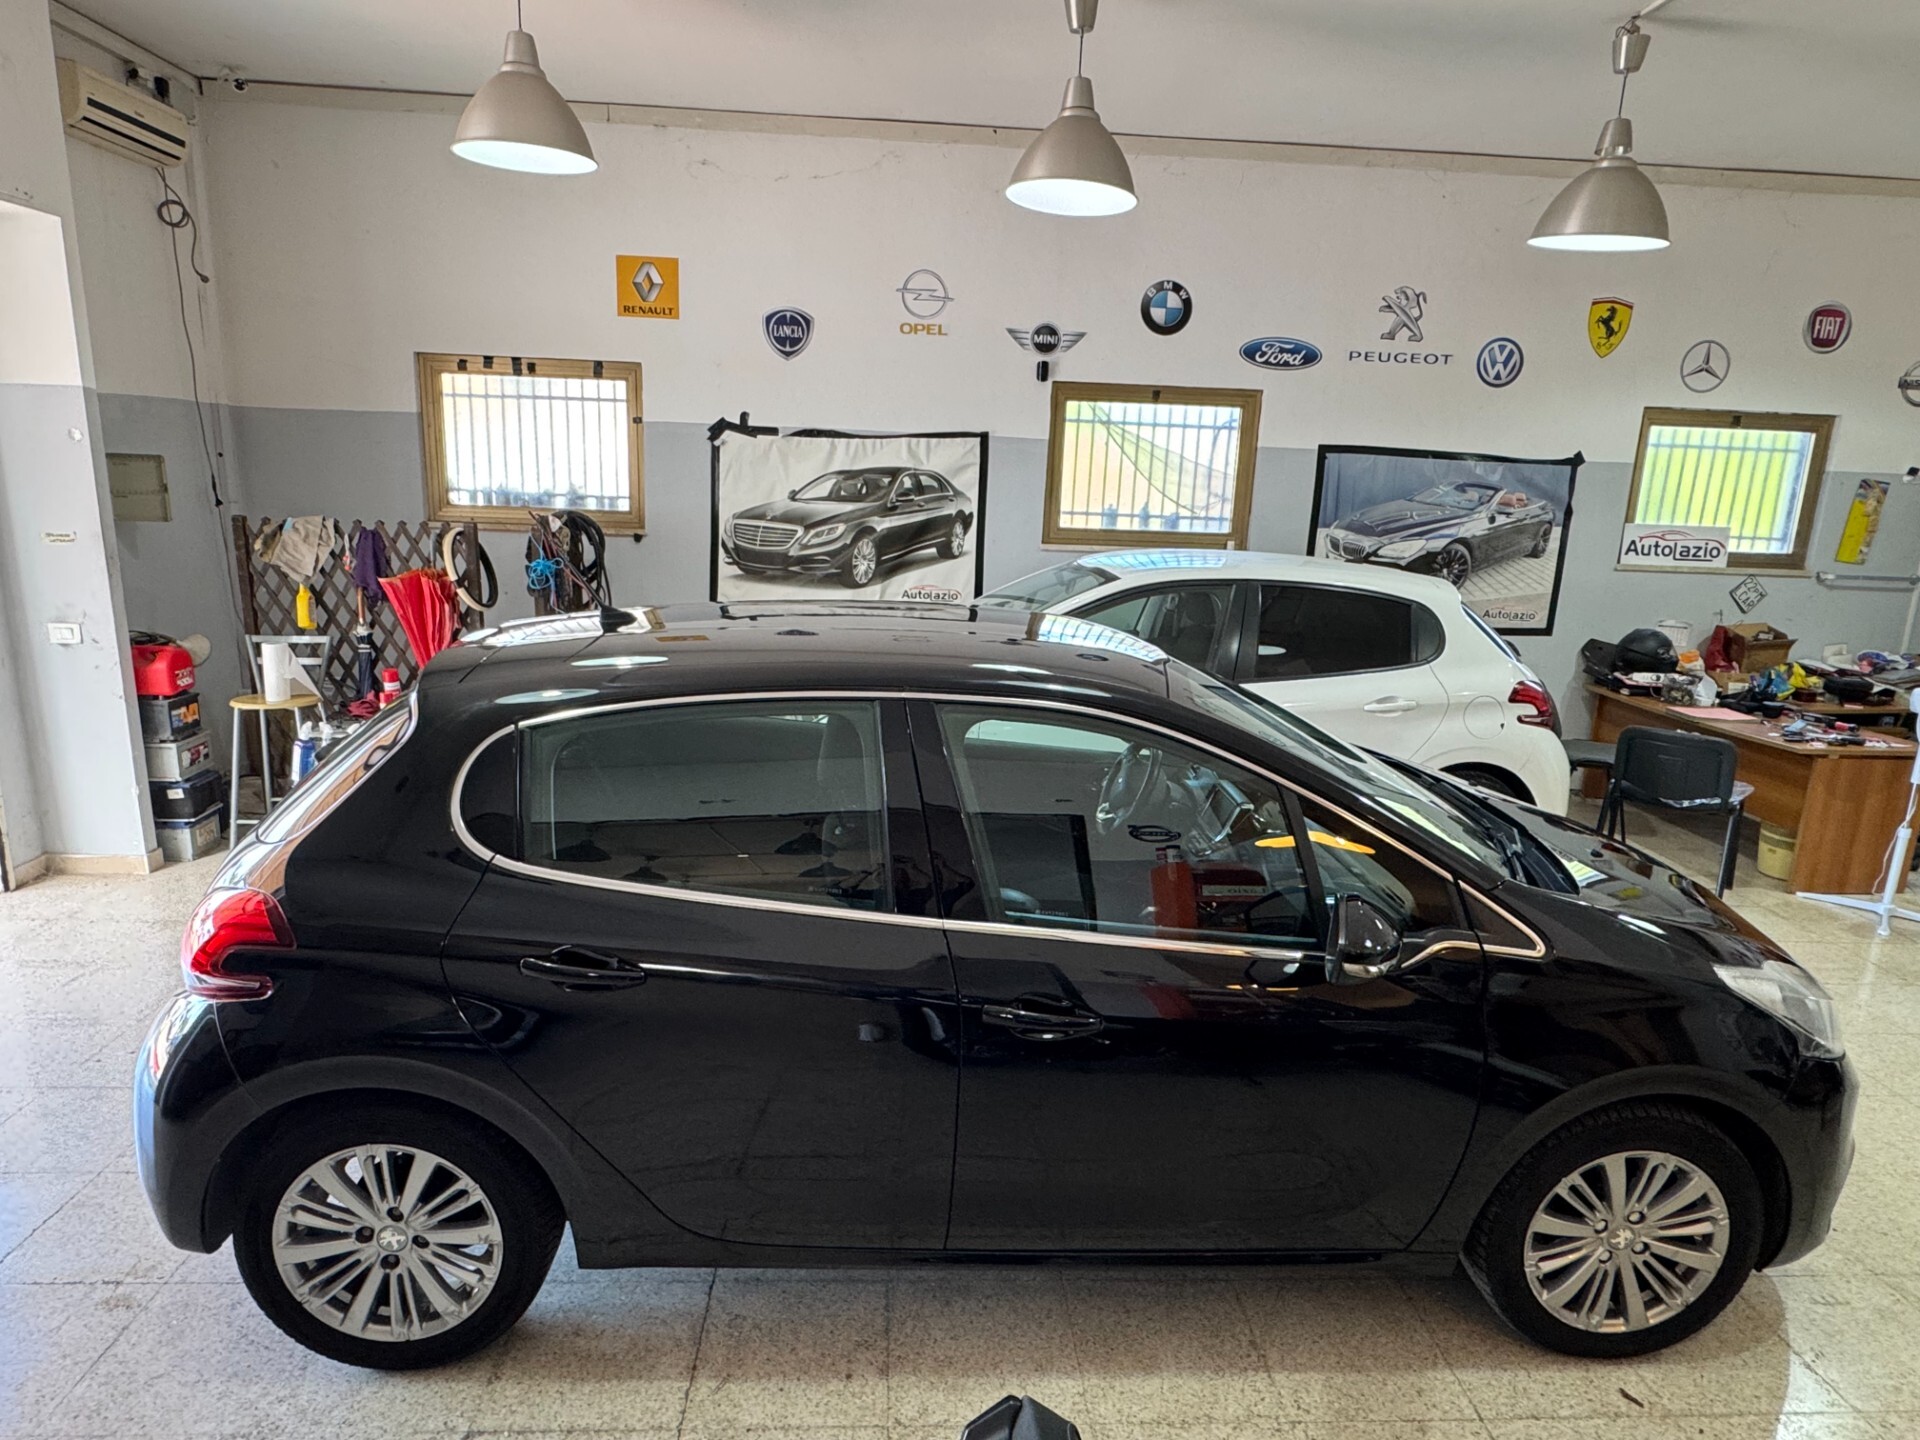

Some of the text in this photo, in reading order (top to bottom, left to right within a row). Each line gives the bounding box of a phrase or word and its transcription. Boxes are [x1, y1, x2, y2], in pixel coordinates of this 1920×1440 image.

[1147, 281, 1189, 300] BMW
[623, 305, 675, 316] RENAULT
[773, 324, 803, 338] LANCIA
[899, 322, 948, 336] OPEL
[1812, 316, 1844, 340] FIAT
[1033, 334, 1059, 345] MINI
[1255, 341, 1306, 366] Ford
[1348, 350, 1454, 366] PEUGEOT
[1624, 540, 1721, 562] AutoLazio
[901, 589, 959, 602] AutoLazio
[1482, 609, 1536, 622] AutoLazio
